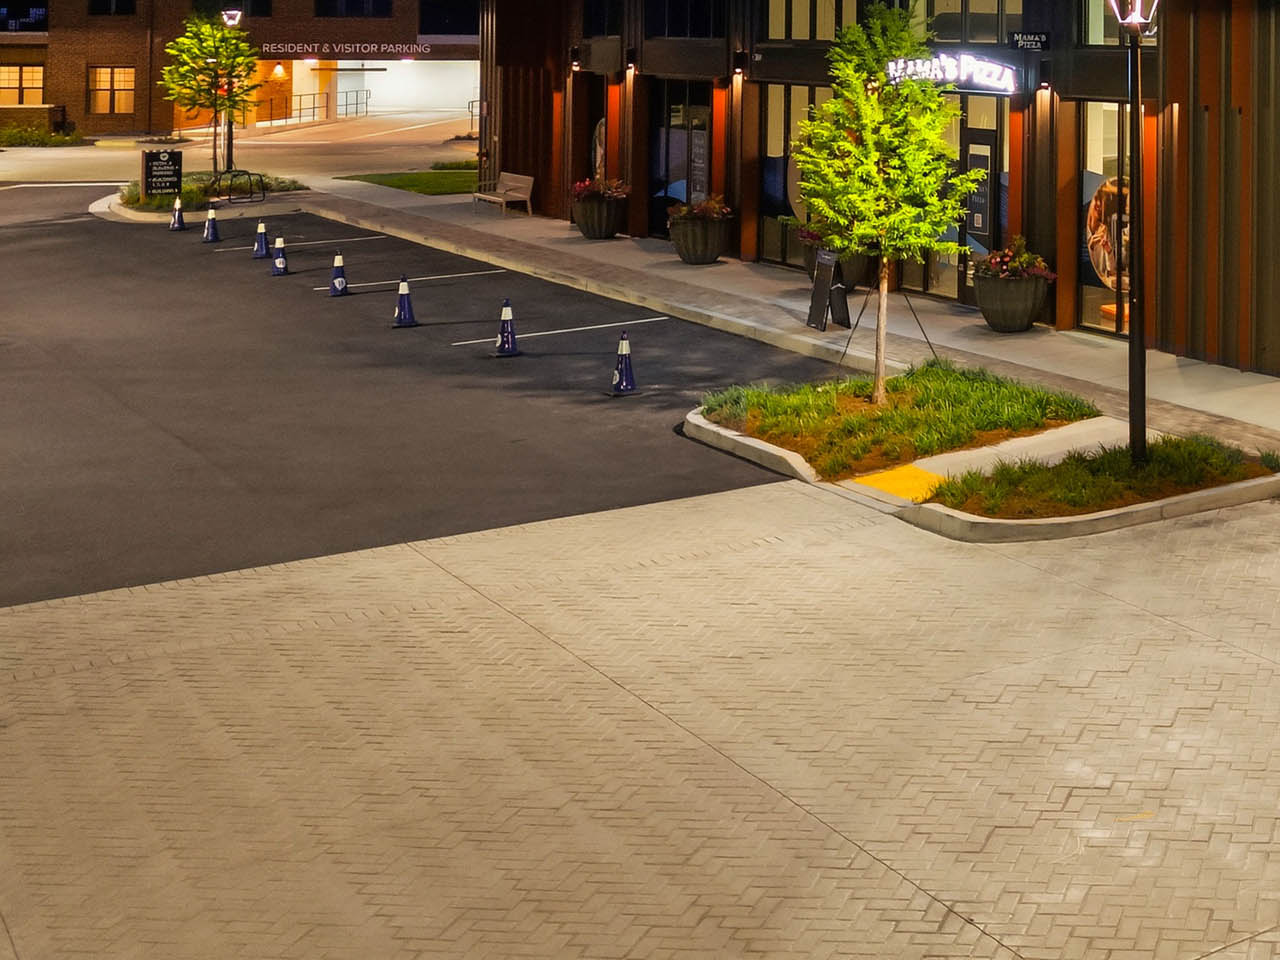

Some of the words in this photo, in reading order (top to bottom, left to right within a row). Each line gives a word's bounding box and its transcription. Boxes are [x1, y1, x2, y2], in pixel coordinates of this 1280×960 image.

[262, 43, 320, 53] RESIDENT
[321, 43, 330, 53] &
[332, 43, 378, 53] VISITOR
[380, 43, 431, 54] PARKING
[1017, 41, 1042, 49] PIZZA
